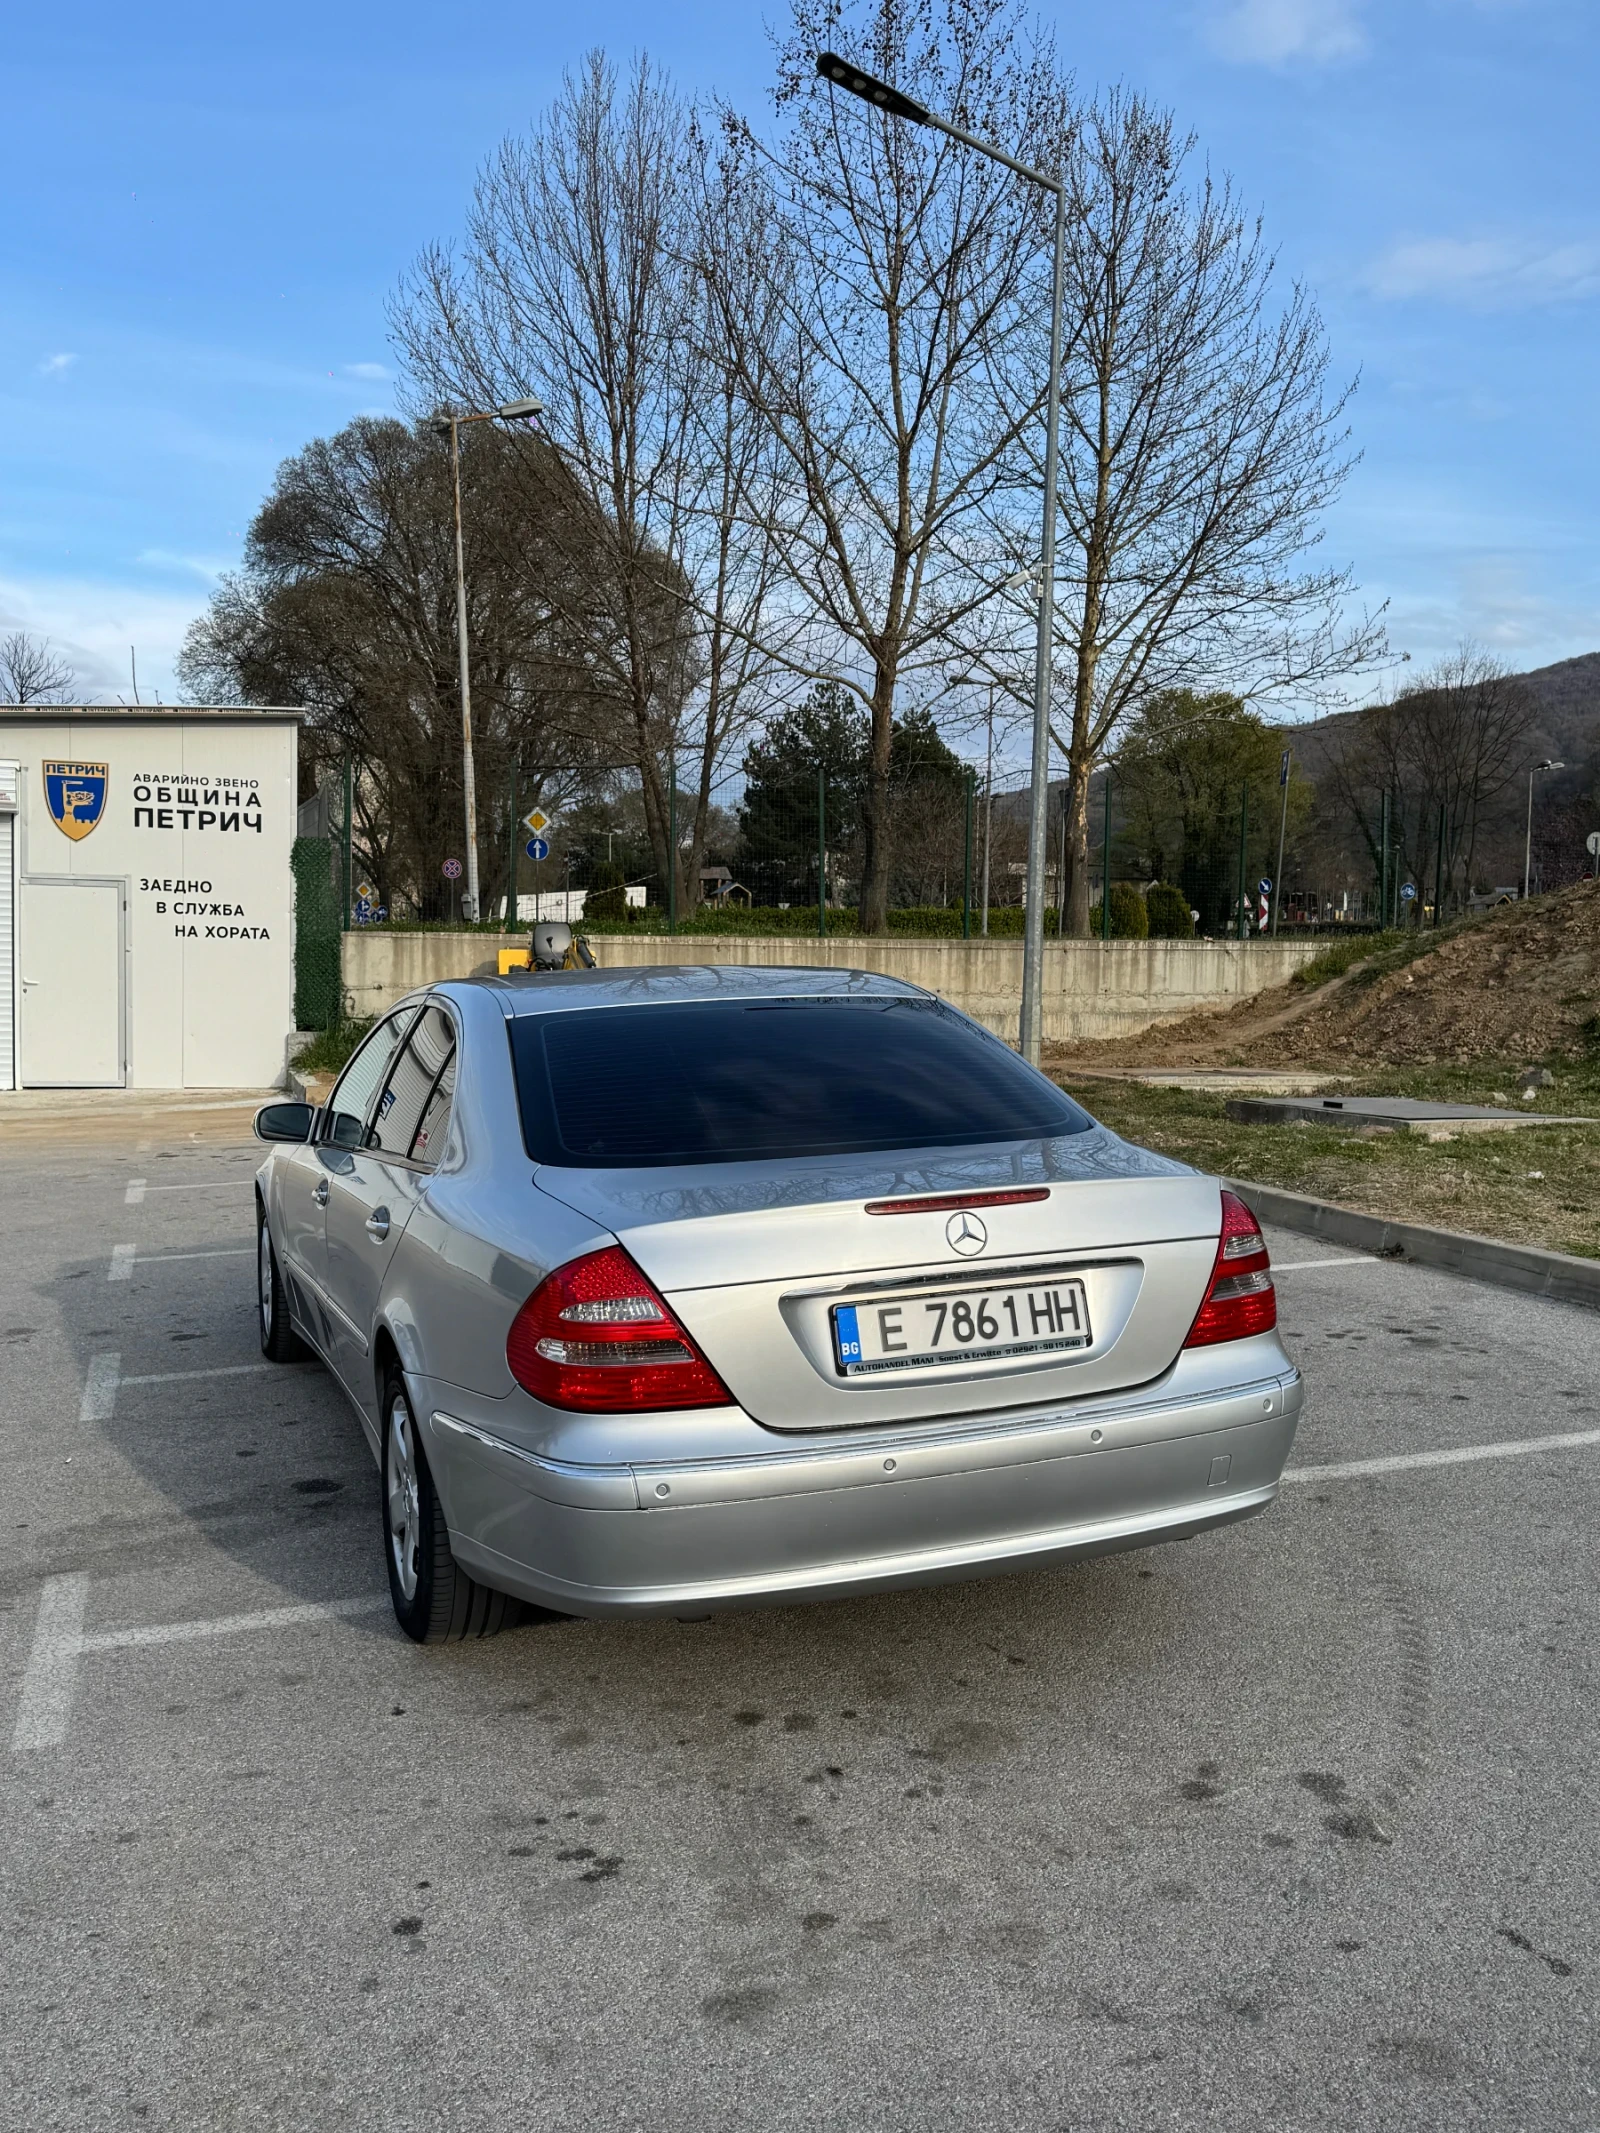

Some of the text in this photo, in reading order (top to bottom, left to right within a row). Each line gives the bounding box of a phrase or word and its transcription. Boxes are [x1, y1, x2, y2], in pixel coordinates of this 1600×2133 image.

[46, 763, 105, 776] ПЕТРИЧ
[133, 773, 259, 789] АВАРИЙНО ЗВЕНО
[133, 785, 262, 808] ОБЩИНА
[134, 807, 262, 833] ПЕТРИЧ
[140, 878, 212, 894] ЗАЕДНО
[156, 901, 245, 917] В СЛУЖБА
[175, 925, 270, 940] НА ХОРАТА
[878, 1288, 1081, 1353] E 7861 HH
[841, 1341, 859, 1356] BG
